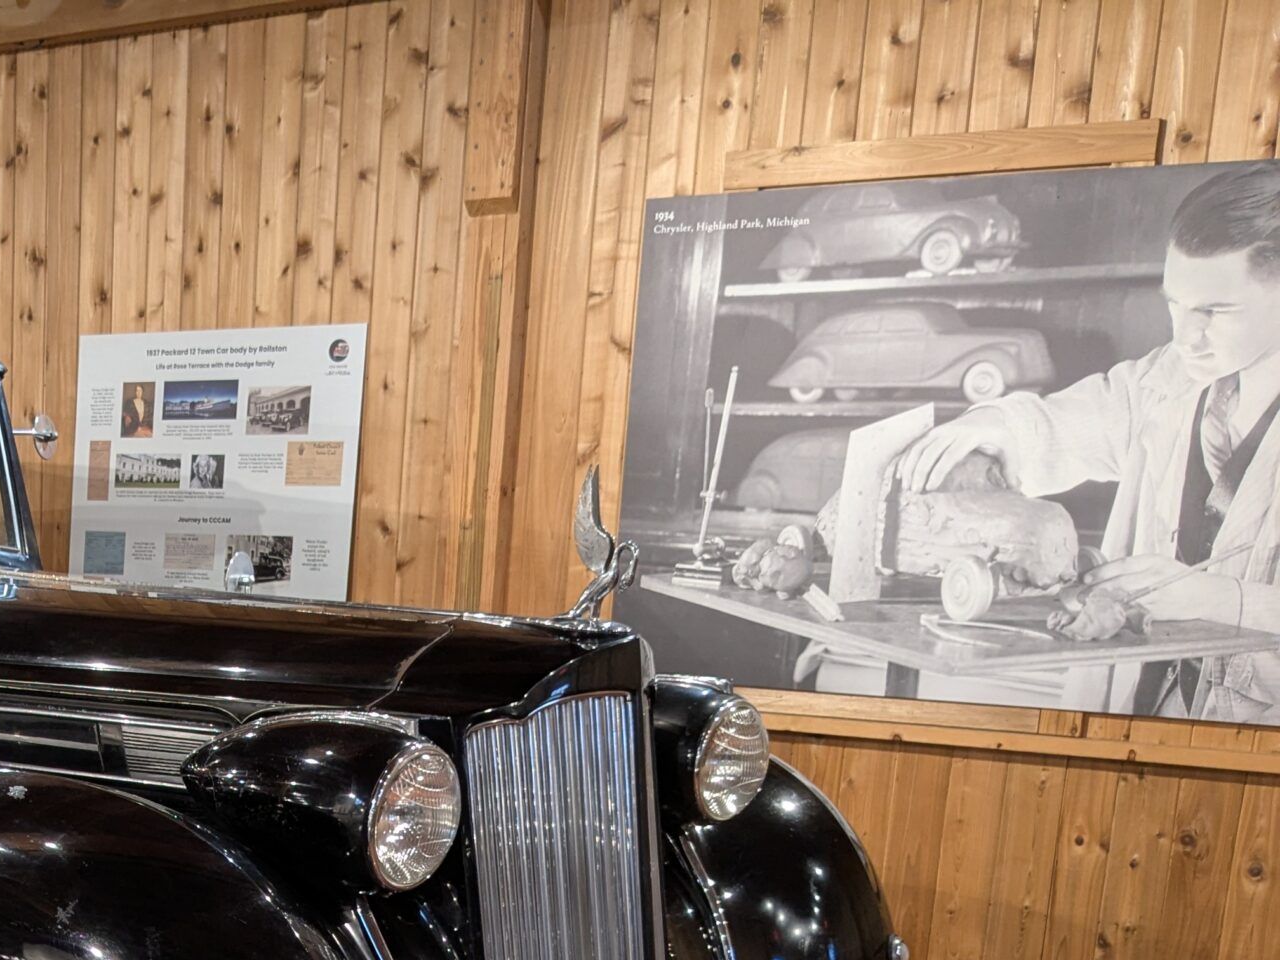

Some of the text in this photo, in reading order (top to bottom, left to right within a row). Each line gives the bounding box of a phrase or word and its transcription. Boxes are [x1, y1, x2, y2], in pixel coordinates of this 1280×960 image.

[654, 211, 675, 221] 1934
[653, 215, 810, 236] Chrysler, Highland Park, Michigan
[161, 347, 188, 356] Packard
[230, 346, 247, 356] body
[248, 346, 257, 355] by
[235, 361, 254, 369] Dodge
[255, 360, 275, 368] family
[178, 516, 201, 524] Journey
